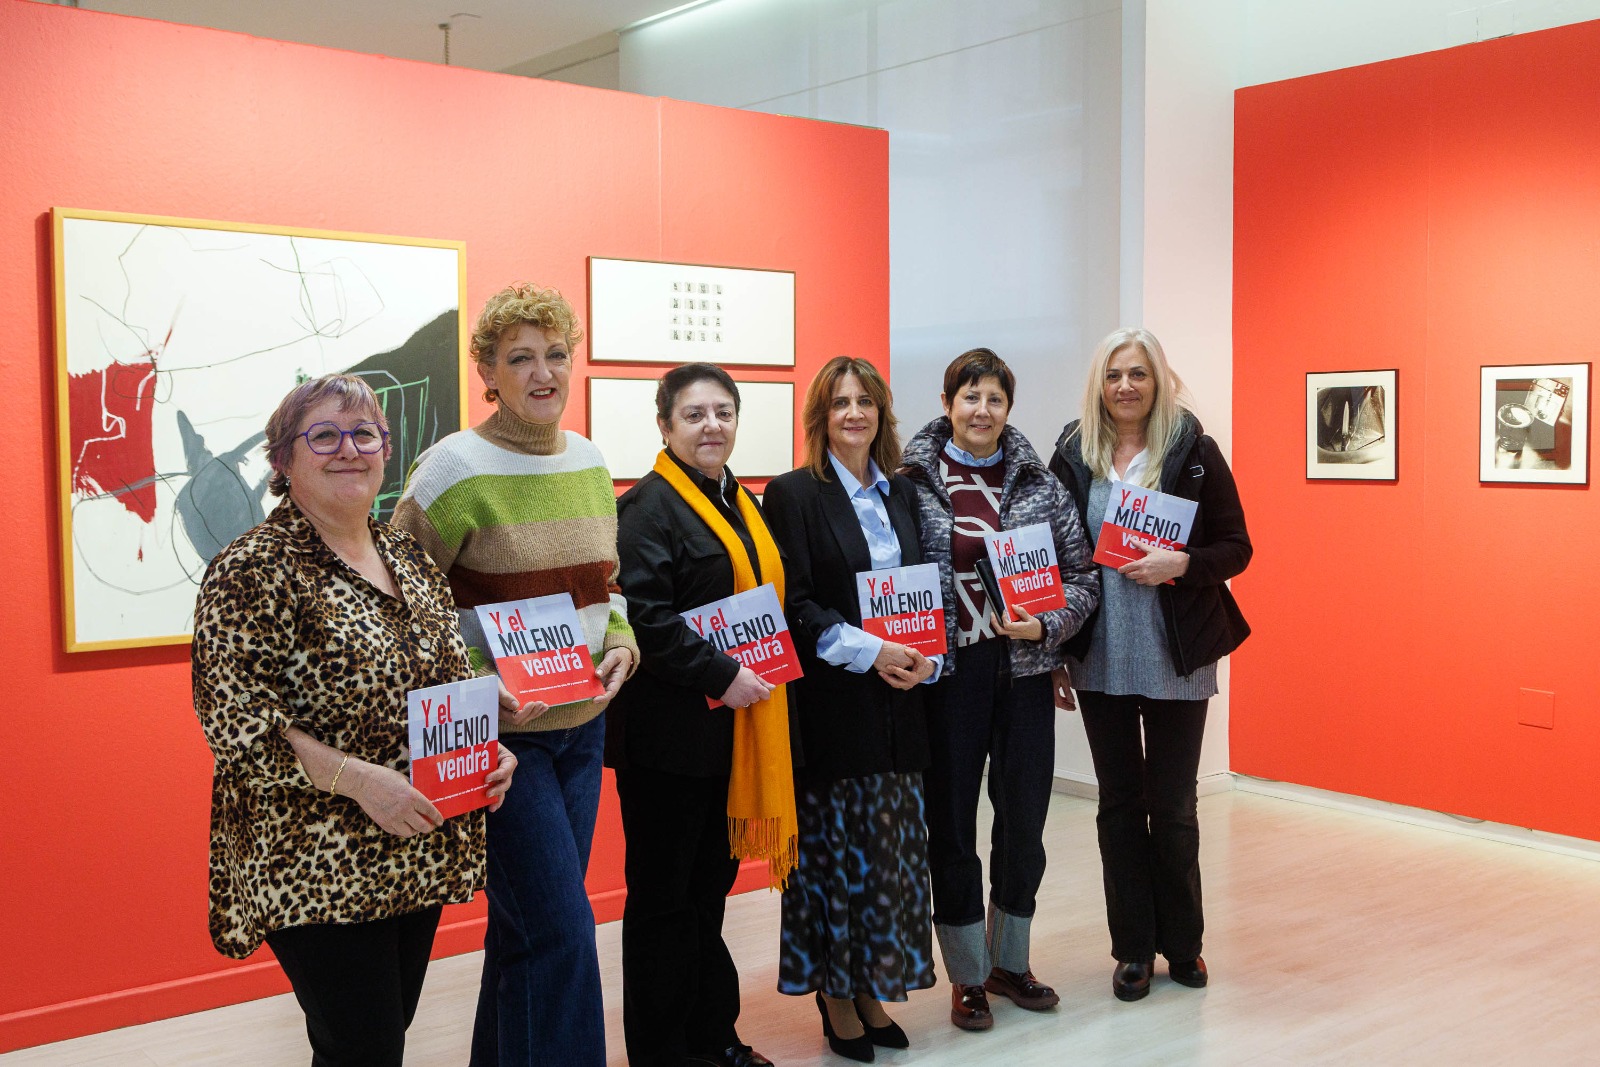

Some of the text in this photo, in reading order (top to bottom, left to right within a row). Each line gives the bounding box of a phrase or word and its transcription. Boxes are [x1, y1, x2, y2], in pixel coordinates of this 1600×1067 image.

[1121, 489, 1148, 513] Y el
[1114, 506, 1181, 541] MILENIO
[993, 537, 1016, 558] Y el
[998, 548, 1049, 578] MILENIO
[867, 575, 895, 597] Y el
[1011, 567, 1054, 594] vendrá
[870, 590, 934, 618] MILENIO
[489, 608, 527, 634] Y el
[691, 607, 728, 636] Y el
[884, 609, 936, 636] vendrá
[497, 623, 575, 657] MILENIO
[521, 647, 584, 677] vendrá
[421, 694, 452, 728] Y el
[422, 714, 489, 758] MILENIO
[436, 741, 489, 782] vendrá
